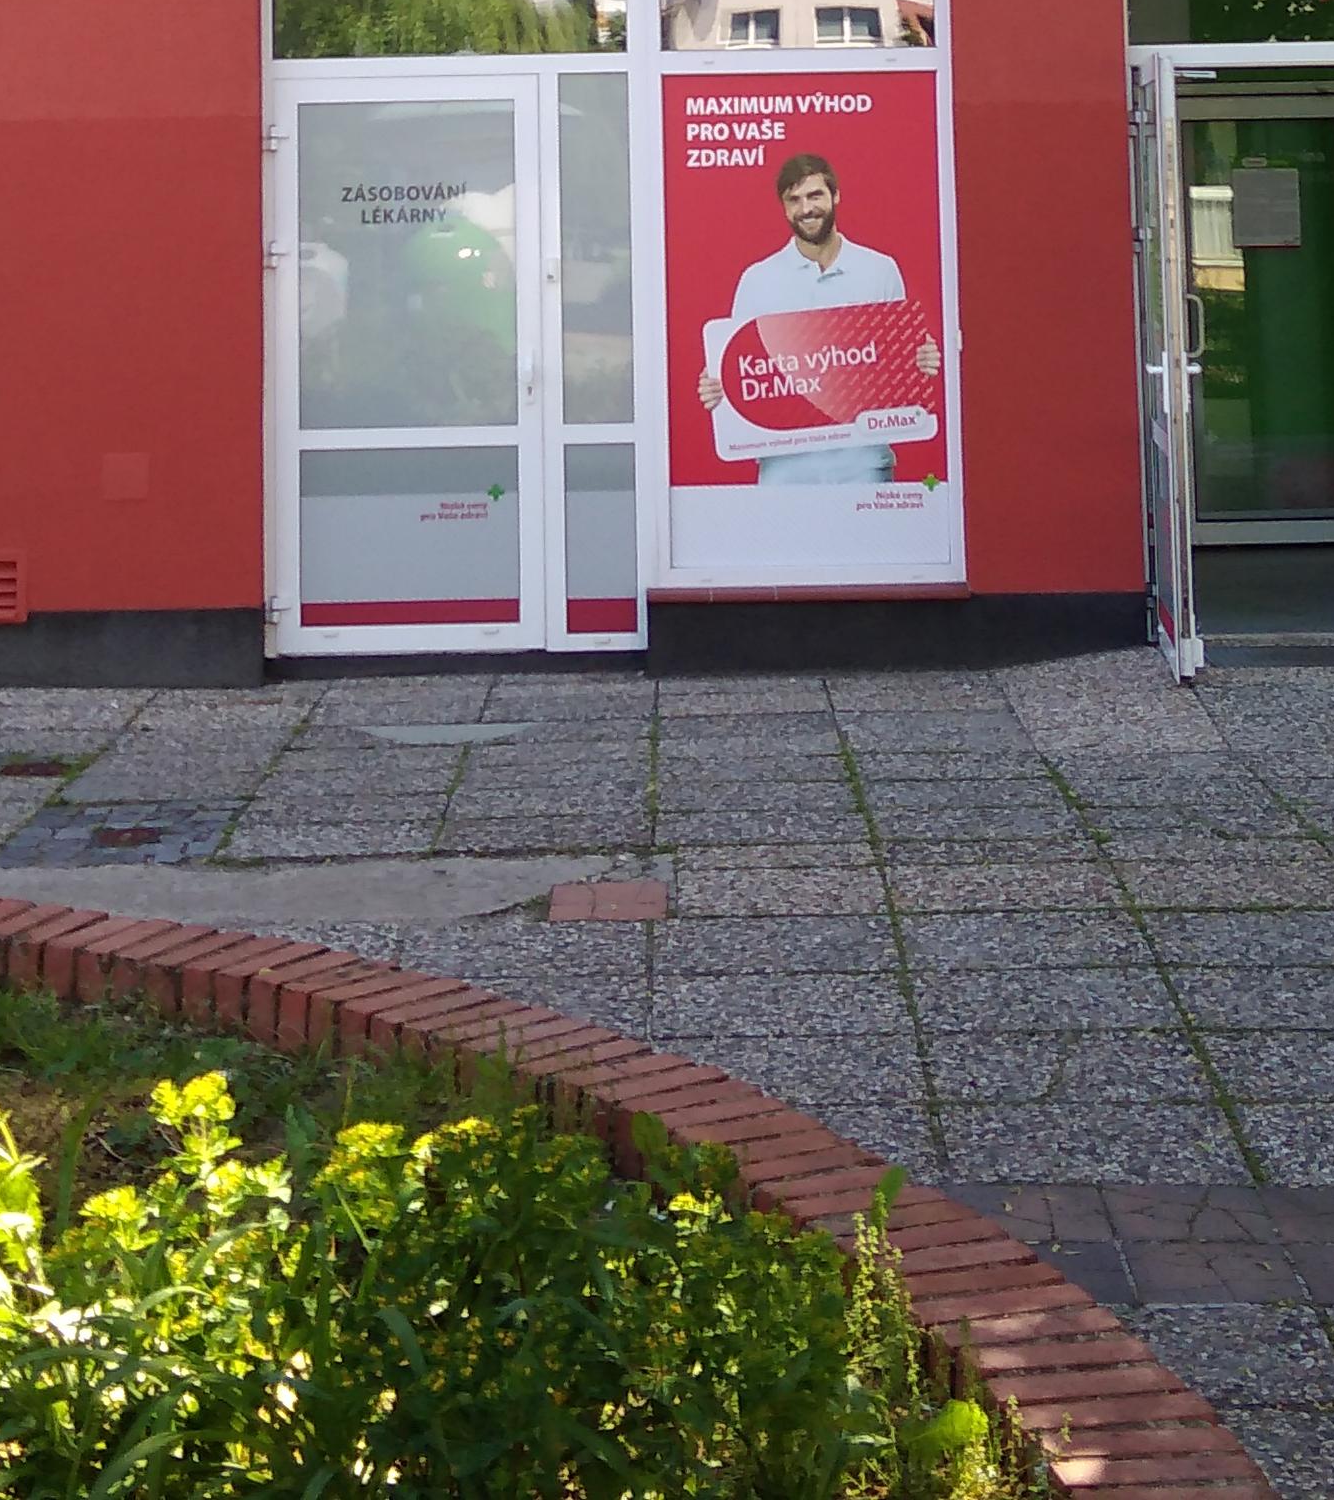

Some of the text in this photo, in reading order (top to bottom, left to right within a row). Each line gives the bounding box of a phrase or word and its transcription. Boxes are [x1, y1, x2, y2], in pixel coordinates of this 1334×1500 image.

[685, 91, 873, 116] MAXIMUM VÝHOD
[686, 118, 786, 142] PRO VAŠE
[685, 144, 765, 168] ZDRAVÍ
[341, 181, 467, 202] ZÁSOBOVÁNÍ
[361, 205, 446, 224] LÉKÁRNY
[738, 340, 878, 378] Karta výhod
[741, 374, 822, 402] Dr.Max
[867, 414, 917, 431] Dr.Max
